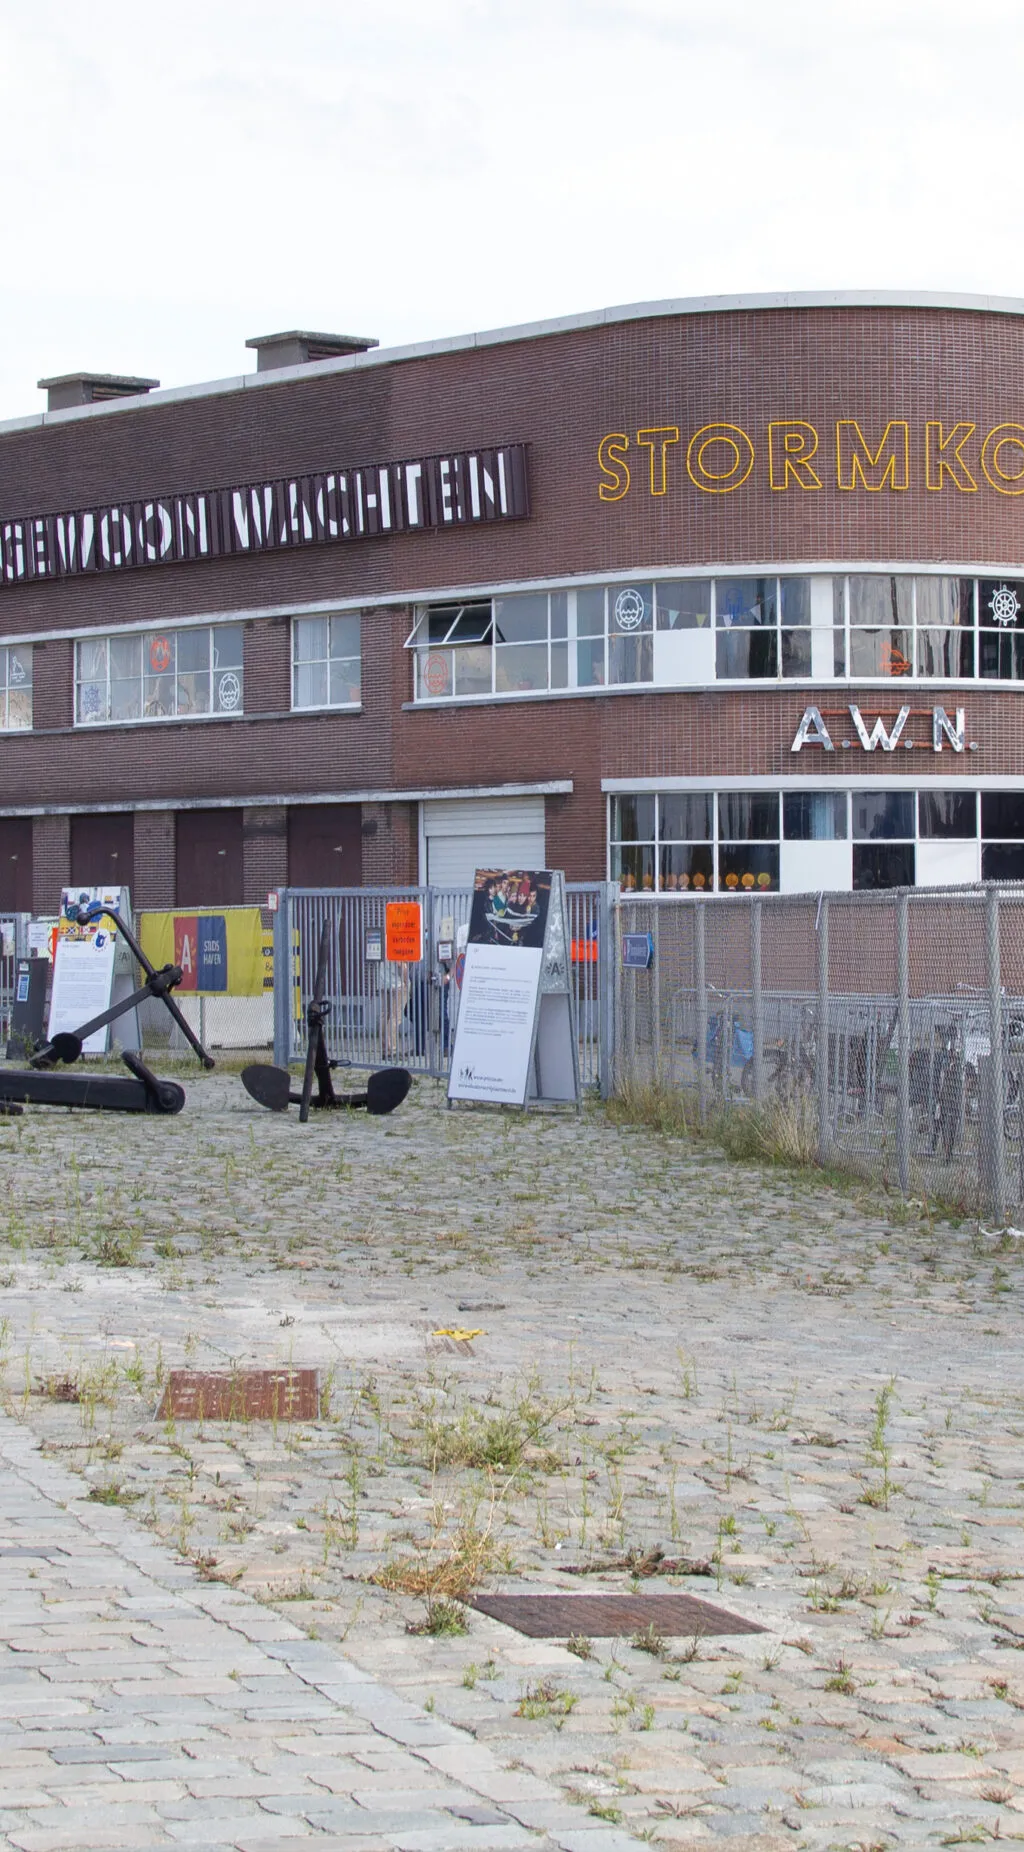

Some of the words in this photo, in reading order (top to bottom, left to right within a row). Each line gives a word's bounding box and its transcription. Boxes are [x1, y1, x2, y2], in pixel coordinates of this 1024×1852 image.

[0, 497, 208, 580] GEWOON
[233, 452, 507, 547] WACHTEN
[790, 704, 979, 752] A.W.N.
